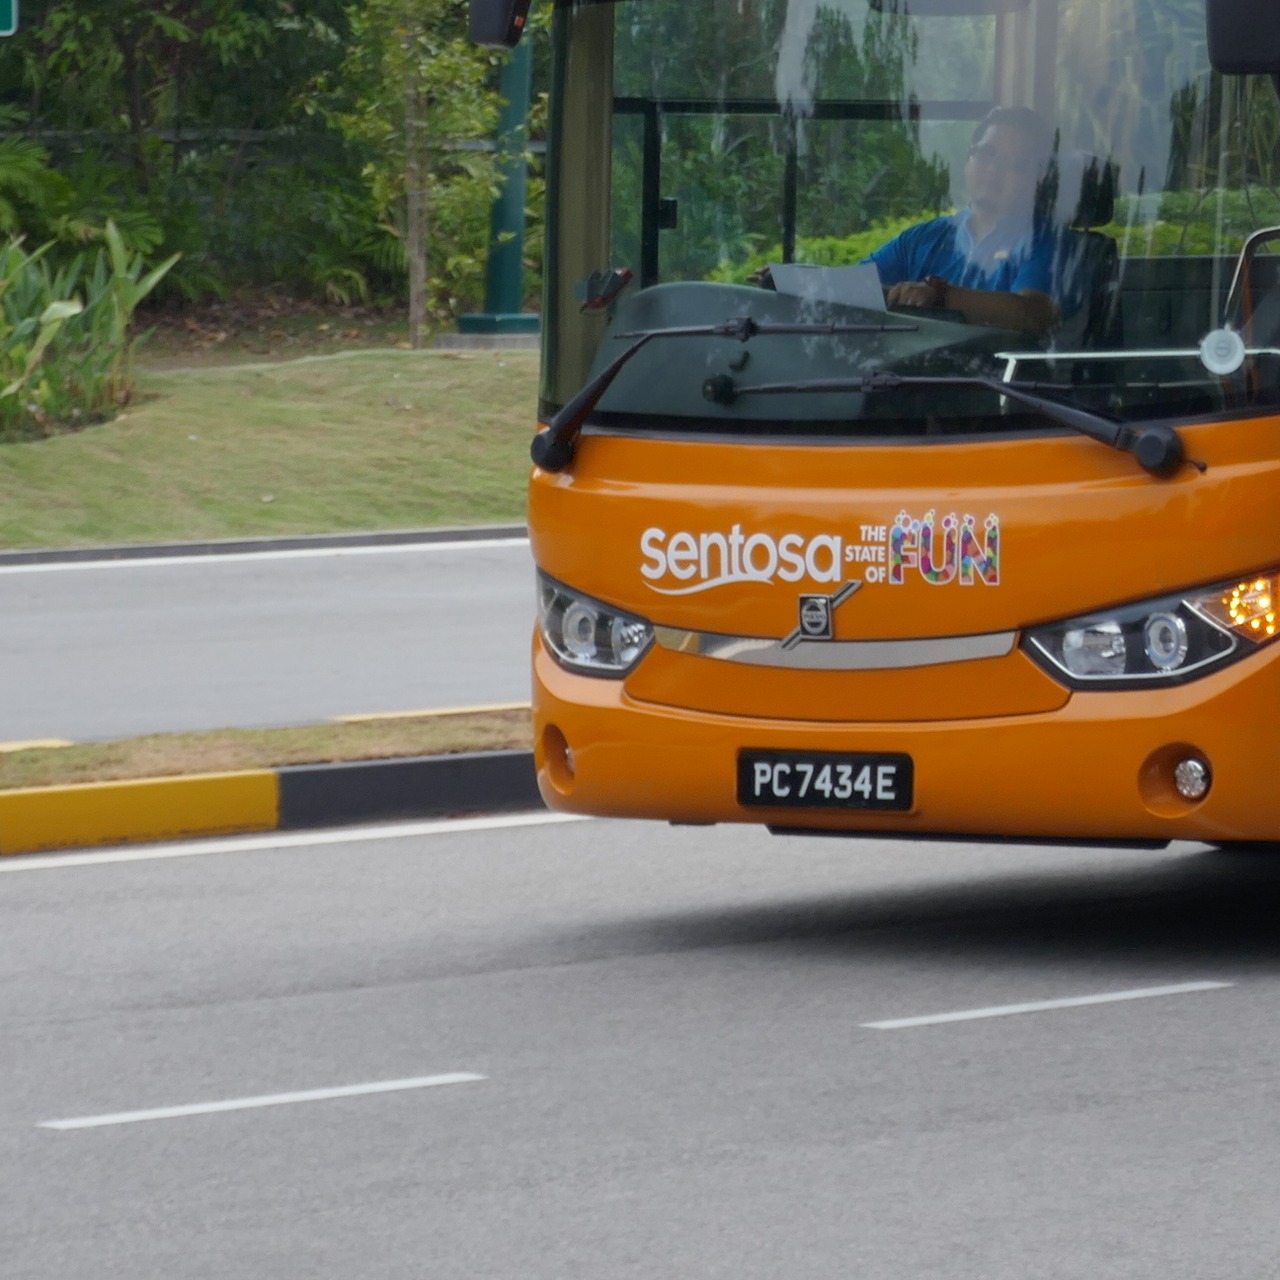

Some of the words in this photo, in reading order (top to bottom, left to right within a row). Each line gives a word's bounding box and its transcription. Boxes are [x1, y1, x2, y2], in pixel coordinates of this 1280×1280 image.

[860, 525, 887, 542] THE
[640, 524, 842, 583] sentosa
[845, 546, 886, 562] STATE
[889, 510, 1000, 587] FUN
[865, 567, 886, 583] OF
